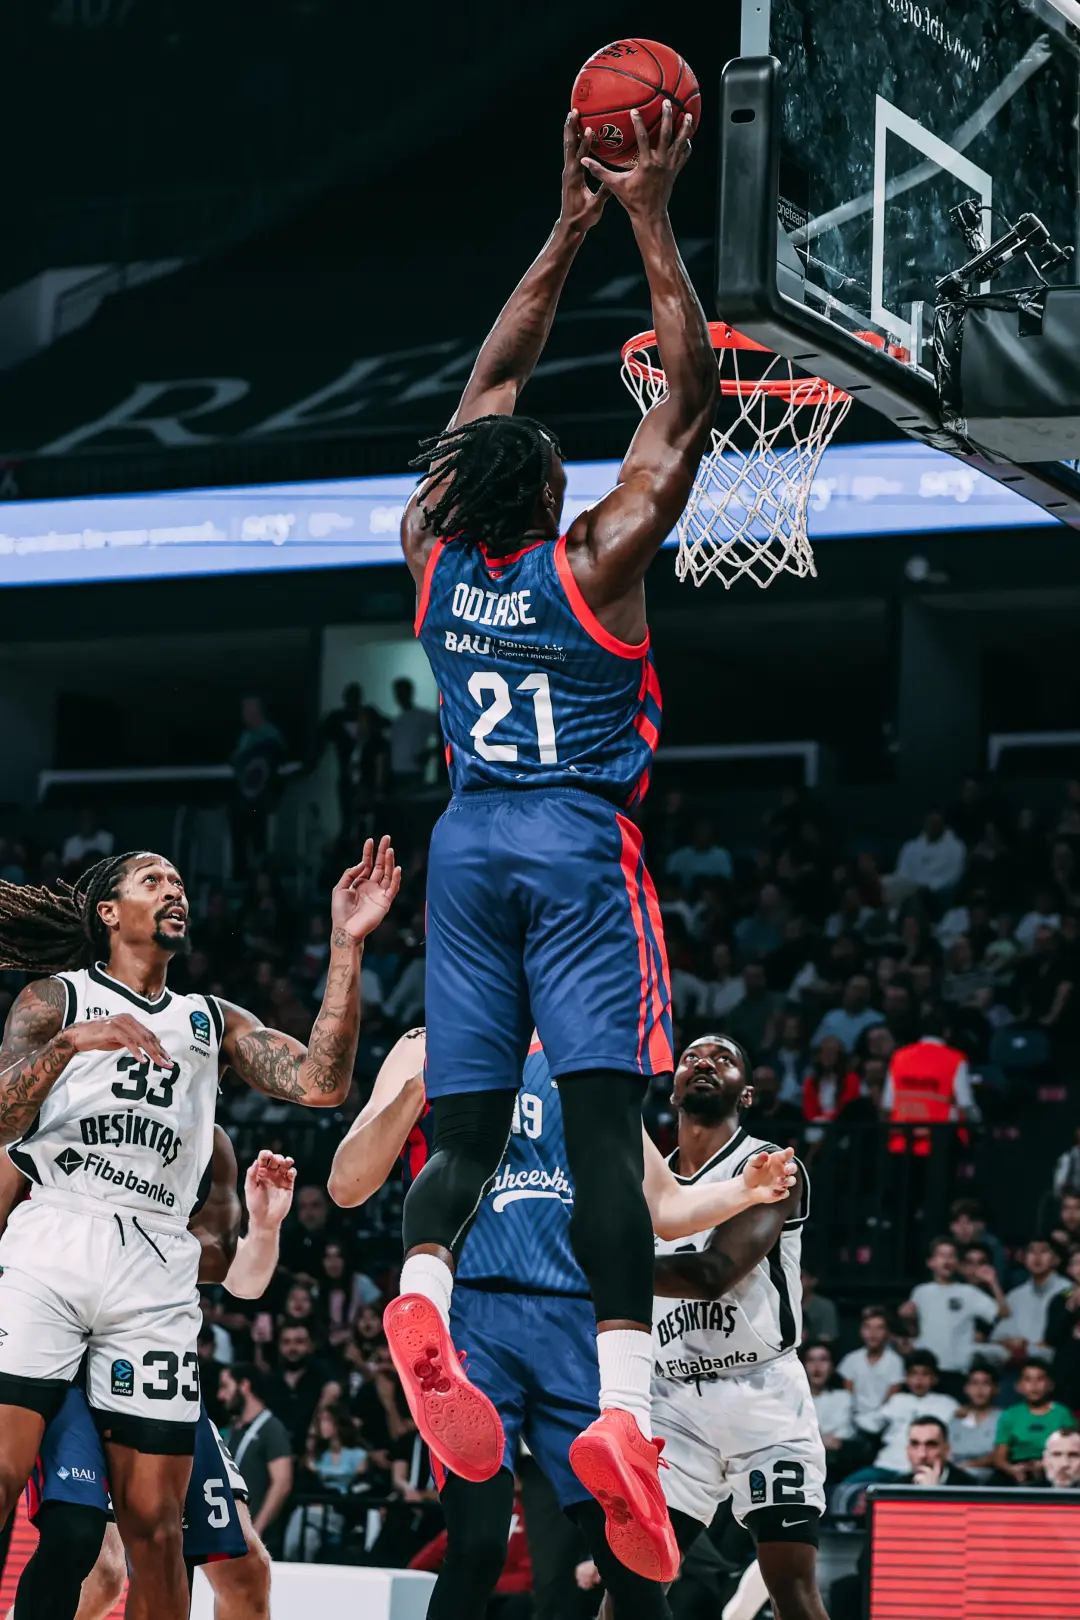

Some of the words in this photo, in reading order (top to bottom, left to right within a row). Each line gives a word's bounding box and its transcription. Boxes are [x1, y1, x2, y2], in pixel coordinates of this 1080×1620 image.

[452, 582, 536, 627] ODIASE
[444, 631, 491, 655] BAU
[467, 671, 558, 764] 21
[111, 1054, 181, 1108] 33
[79, 1108, 182, 1168] BEŞİKTAŞ
[83, 1152, 175, 1208] Fibabanka
[657, 1298, 738, 1348] BEŞİKTAŞ
[142, 1350, 199, 1402] 33
[665, 1350, 758, 1377] Fibabanka
[71, 1467, 96, 1481] BAU
[772, 1460, 805, 1504] 2
[203, 1478, 231, 1529] 5
